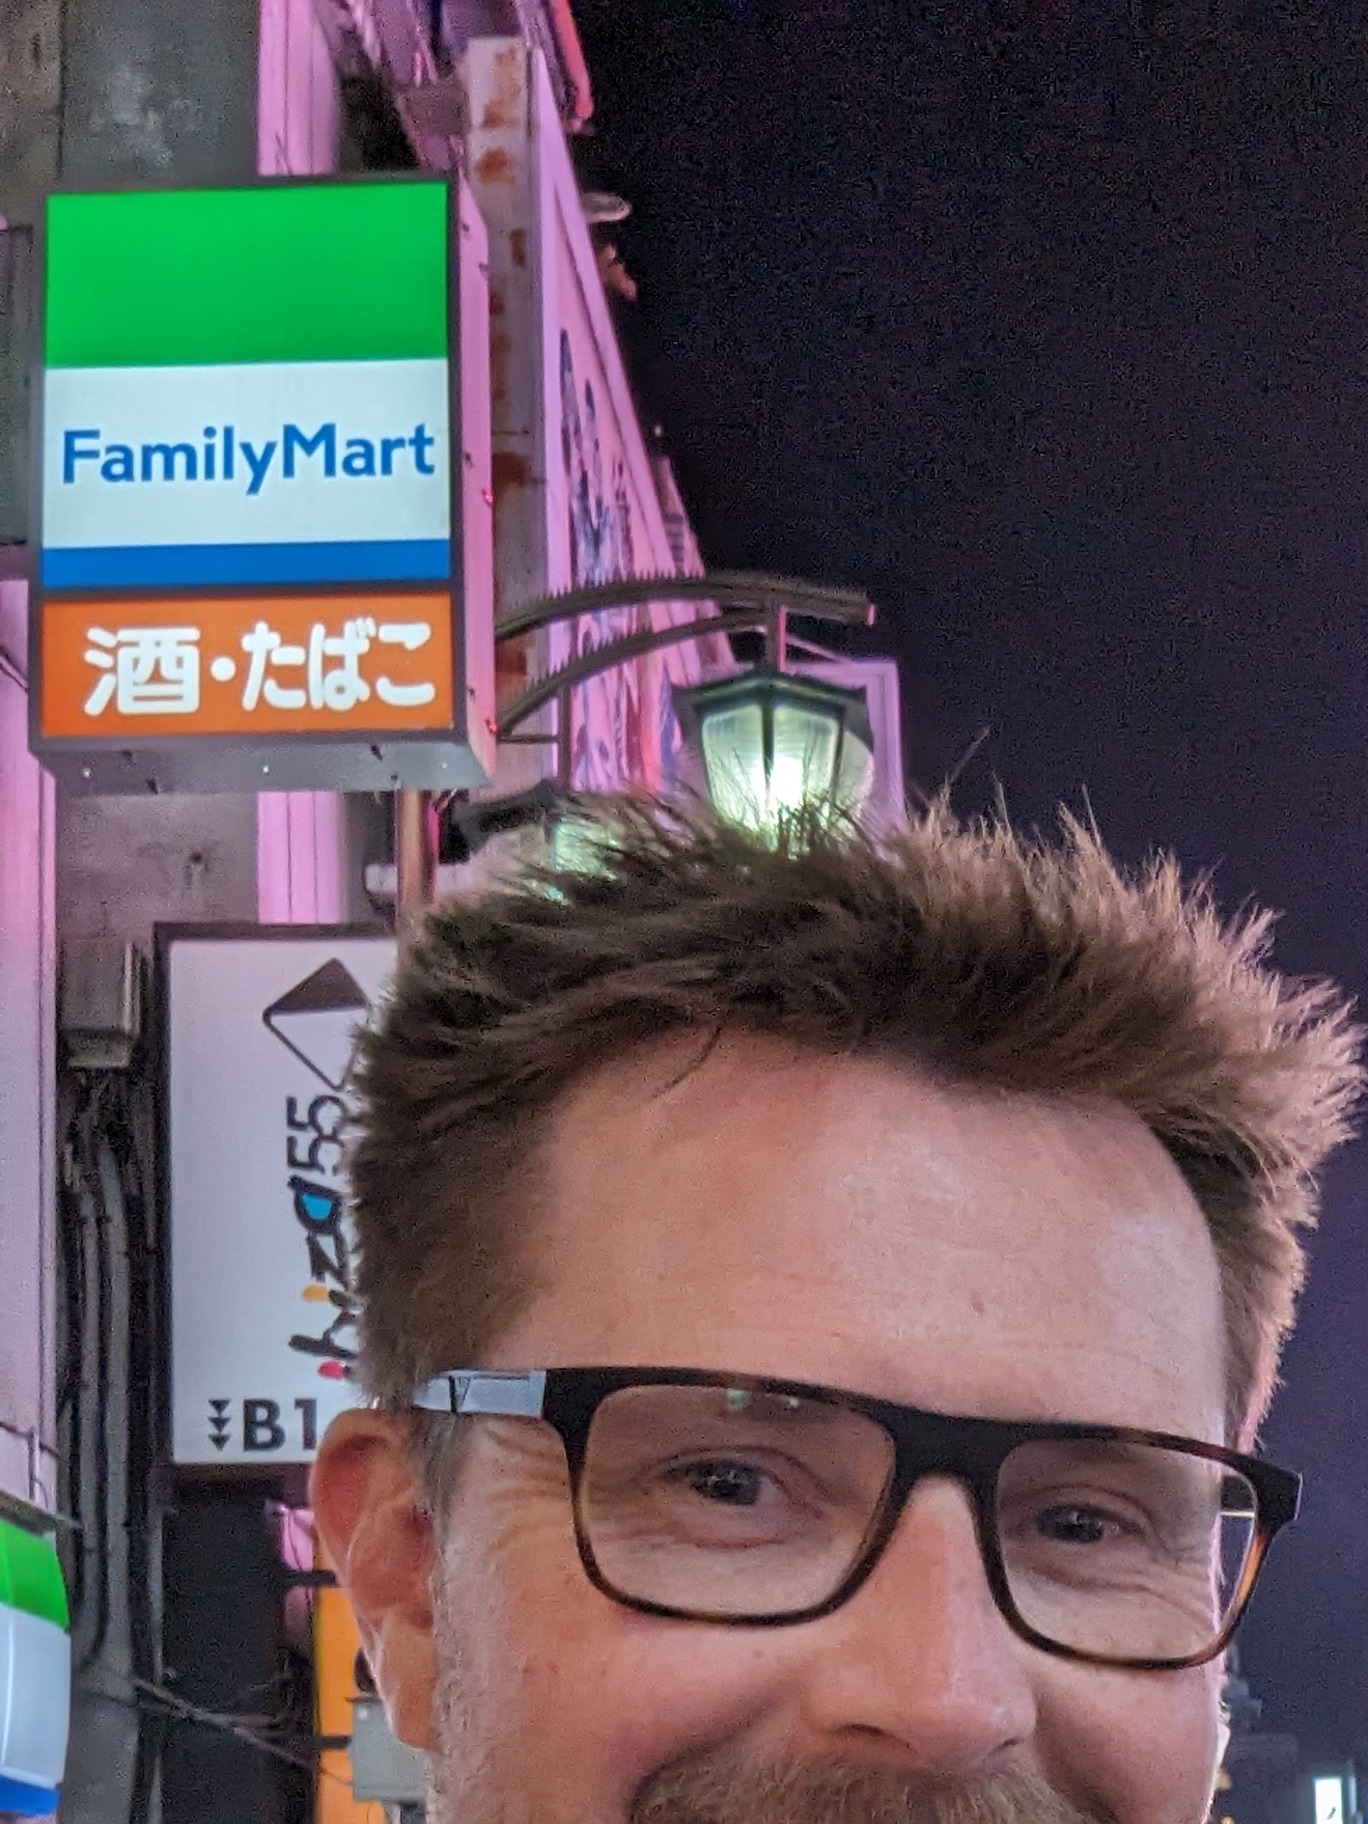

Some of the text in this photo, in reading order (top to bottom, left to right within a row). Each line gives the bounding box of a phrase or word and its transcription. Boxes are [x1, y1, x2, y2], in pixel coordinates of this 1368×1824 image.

[62, 423, 436, 495] FamilyMart
[83, 616, 436, 716] 酒・たばこ
